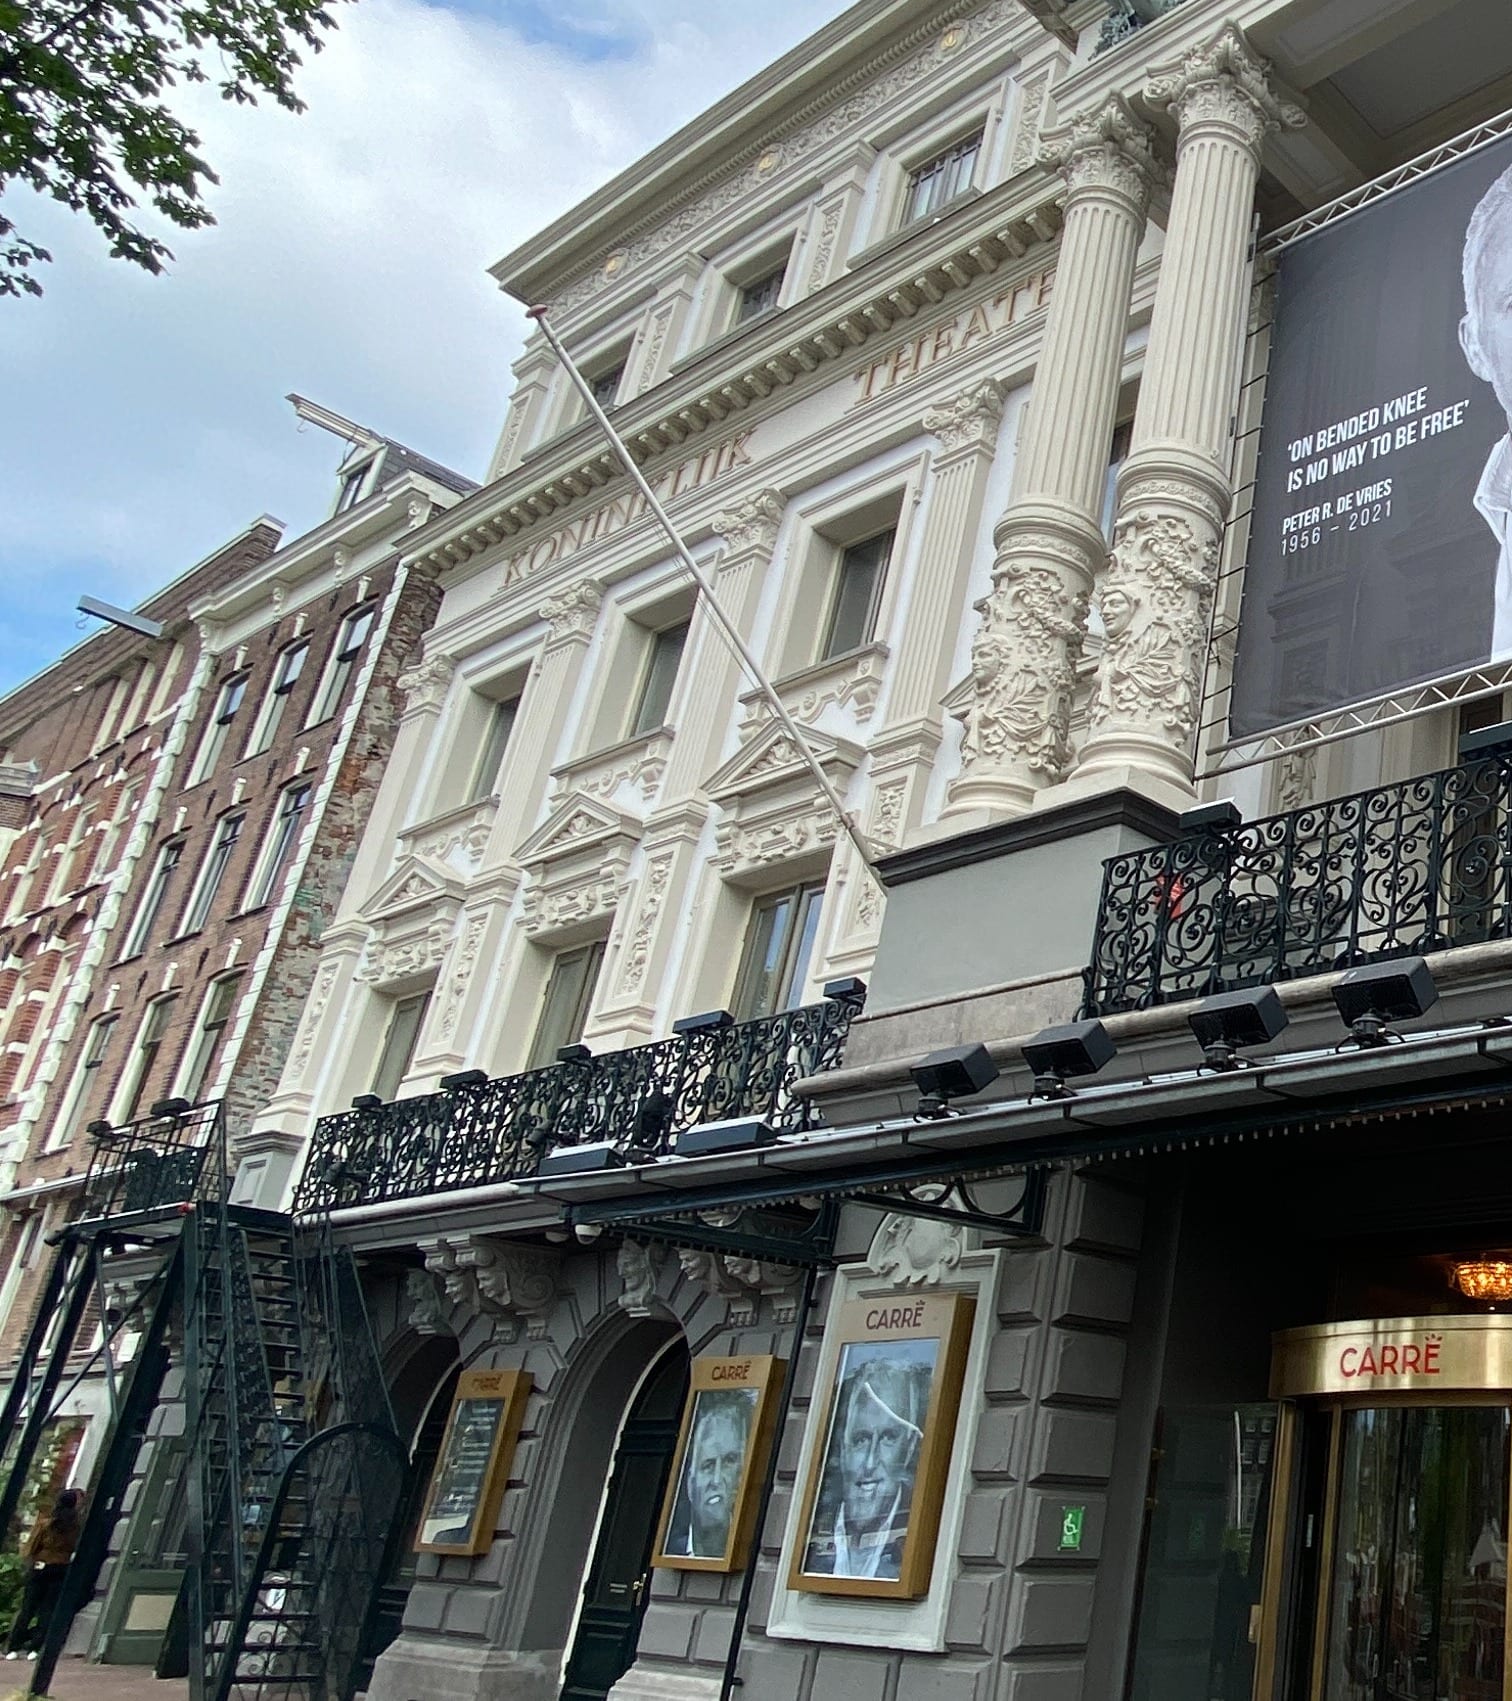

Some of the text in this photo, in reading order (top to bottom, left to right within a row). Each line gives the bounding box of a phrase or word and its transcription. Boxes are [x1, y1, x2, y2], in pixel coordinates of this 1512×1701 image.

[1315, 407, 1380, 453] BENDED
[1382, 386, 1428, 425] KNEE
[1287, 470, 1302, 493] IS
[1306, 457, 1328, 486] NO
[1332, 440, 1369, 475] WAY
[1370, 432, 1392, 459] TO
[1394, 421, 1418, 450] BE
[1280, 526, 1321, 556] 1956
[1348, 500, 1393, 531] 2021
[1282, 478, 1393, 535] PETER R. DE VRIES
